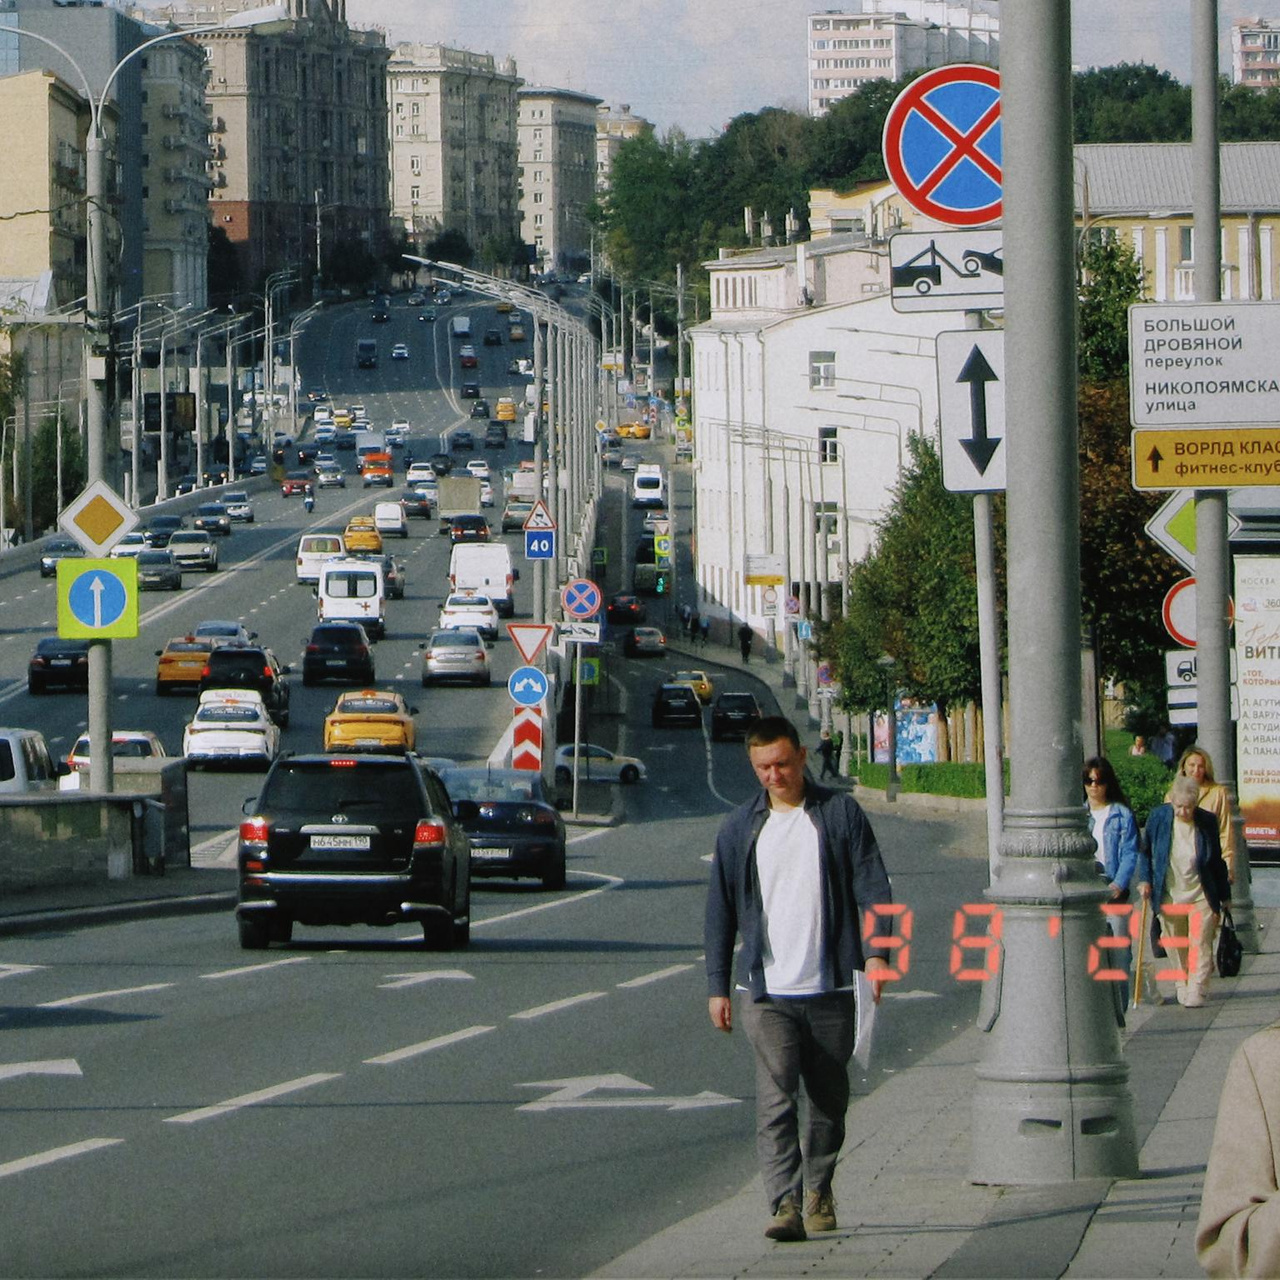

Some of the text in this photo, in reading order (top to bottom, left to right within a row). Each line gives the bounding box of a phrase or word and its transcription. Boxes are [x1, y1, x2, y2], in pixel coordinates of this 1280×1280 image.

[1144, 315, 1236, 333] БОЛЬШОЙ
[1144, 334, 1243, 353] ДРОВЯНОЙ
[1145, 355, 1224, 371] переулок
[1145, 380, 1280, 396] НИКОЛОЯМСКА
[1146, 400, 1197, 414] улица
[1175, 442, 1234, 457] ВОРЛД
[1175, 459, 1280, 475] фитнес-клуб
[530, 539, 549, 552] 40
[1240, 577, 1276, 586] МОСКВА
[1245, 645, 1280, 659] ВИТ
[1253, 735, 1280, 743] ИВАН
[1253, 747, 1280, 755] ПАНА
